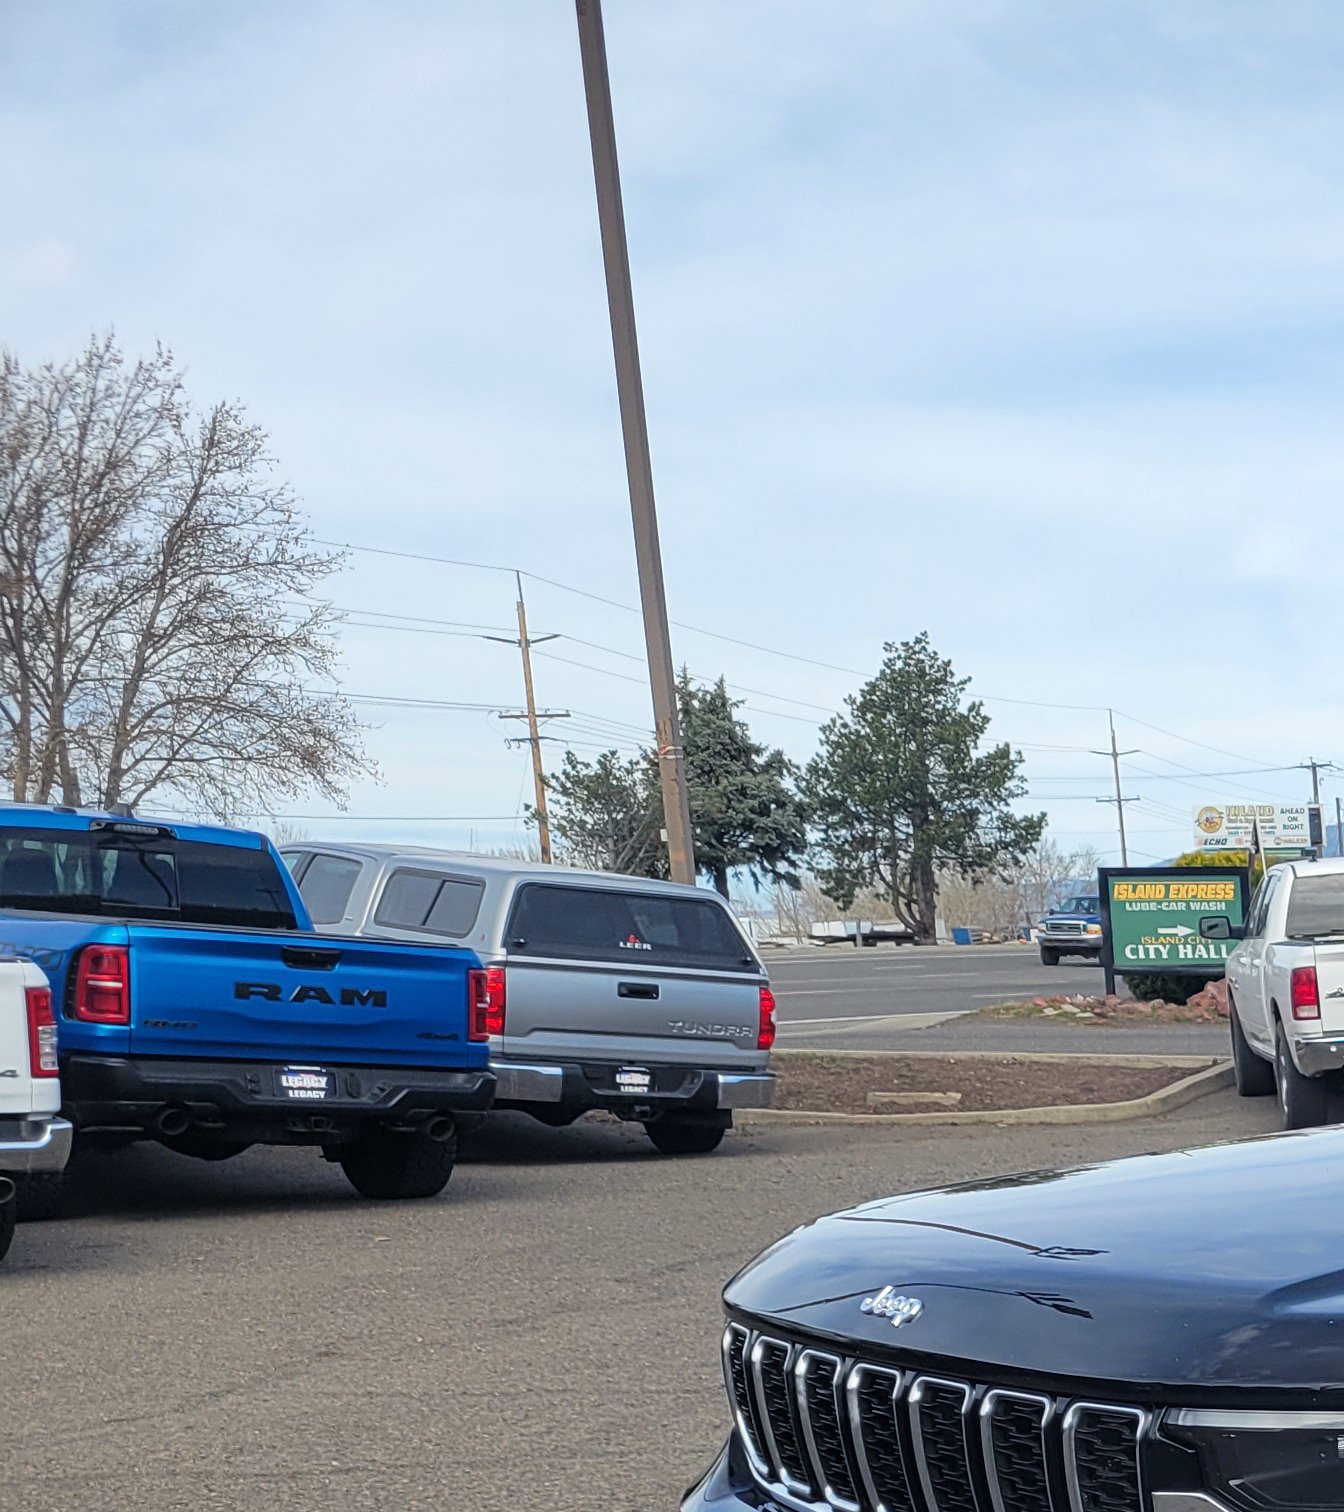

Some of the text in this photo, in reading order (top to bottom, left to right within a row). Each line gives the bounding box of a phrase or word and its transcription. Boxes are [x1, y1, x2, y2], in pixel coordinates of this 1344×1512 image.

[1225, 805, 1274, 817] INLAND
[1280, 807, 1305, 815] AHEAD
[1287, 815, 1299, 823] ON
[1282, 823, 1304, 831] RIGHT
[1203, 837, 1228, 846] ECHO
[1113, 883, 1235, 899] ISLAND EXPRESS
[1189, 901, 1226, 911] WASH
[1141, 936, 1184, 944] ISLAND
[619, 941, 653, 950] LEER
[1124, 943, 1230, 959] CITY HALL
[234, 982, 388, 1008] RAM
[668, 1020, 753, 1038] TUNDRA
[281, 1074, 329, 1088] LEGACY
[288, 1089, 326, 1098] LEGACY
[620, 1085, 648, 1093] LEGACY
[860, 1285, 923, 1328] Jeep
